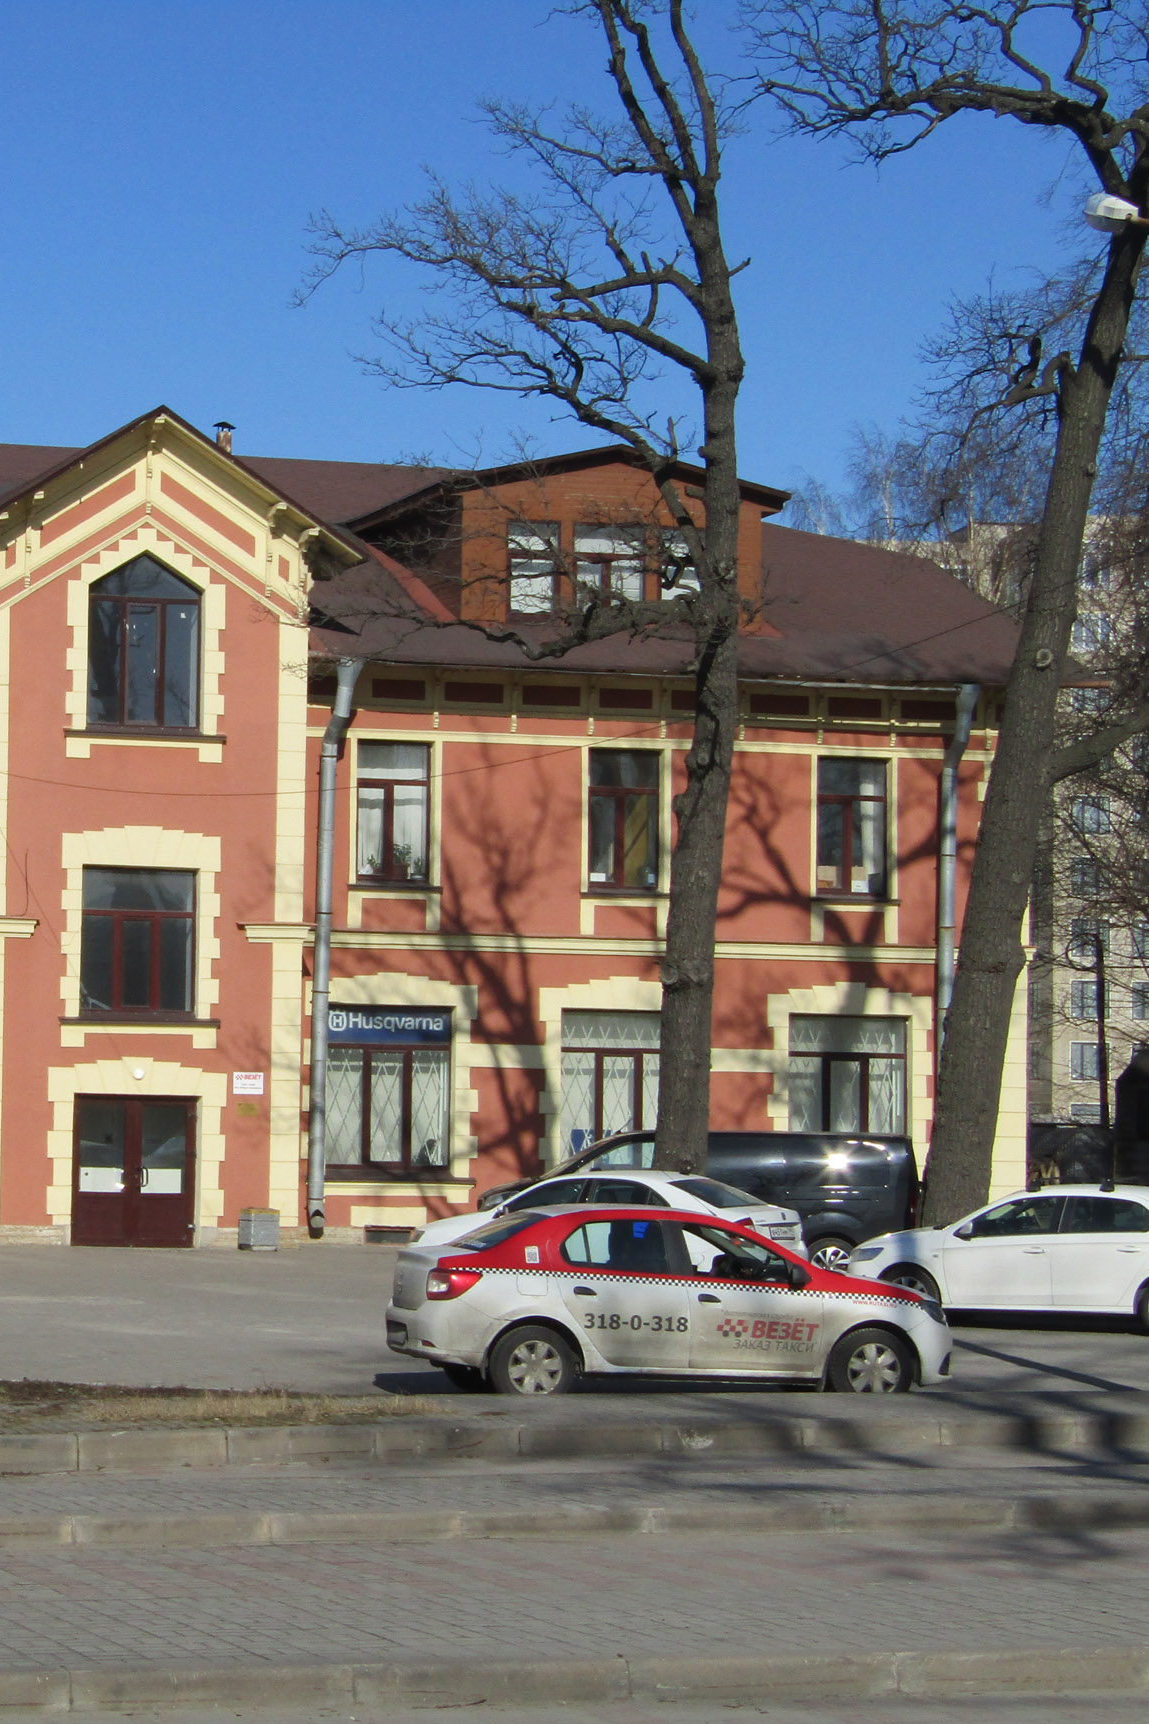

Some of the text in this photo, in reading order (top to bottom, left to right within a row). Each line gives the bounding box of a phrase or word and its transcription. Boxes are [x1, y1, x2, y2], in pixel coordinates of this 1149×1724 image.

[349, 1012, 444, 1032] Husqvarna
[584, 1313, 689, 1333] 318-0-318
[751, 1317, 820, 1342] ВЕЗЁТ
[733, 1339, 815, 1353] ЗАКАЗ ТАКСИ
